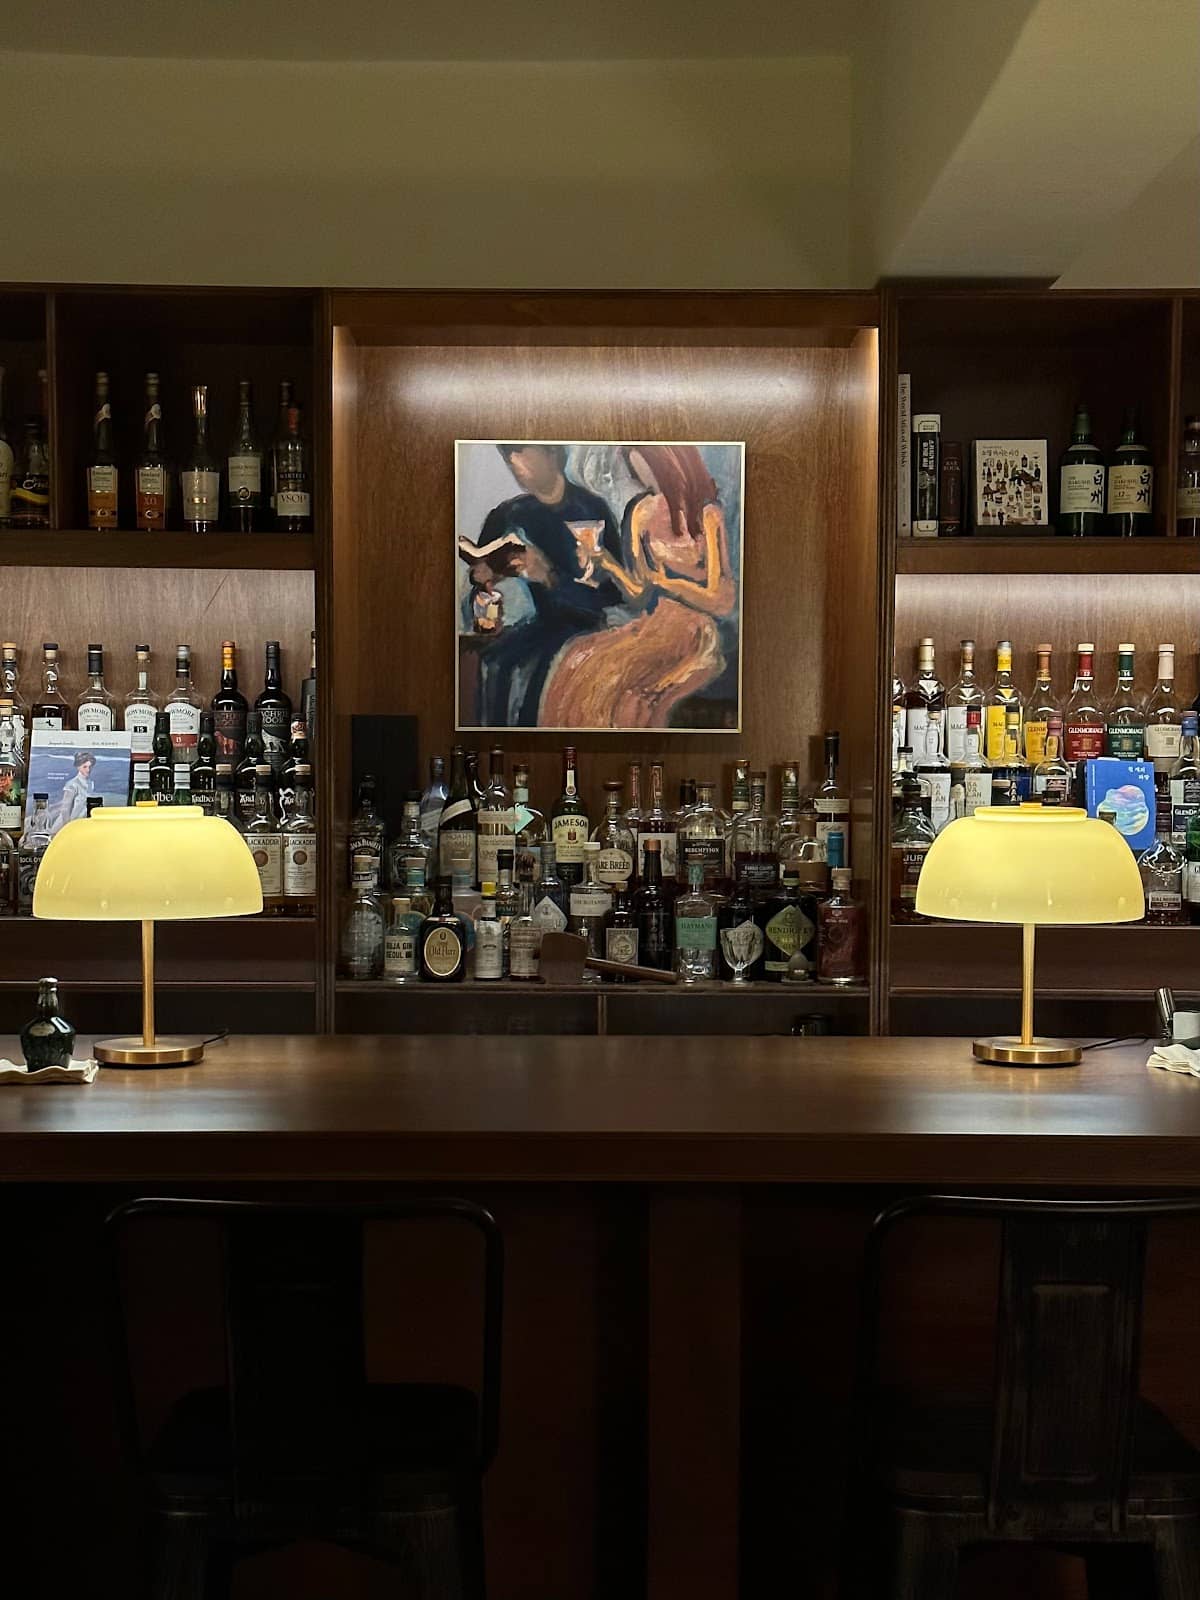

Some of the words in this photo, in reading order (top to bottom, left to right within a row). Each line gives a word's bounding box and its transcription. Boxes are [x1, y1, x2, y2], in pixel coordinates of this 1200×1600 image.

[1090, 469, 1104, 507] 白州
[1136, 468, 1152, 506] 白州
[903, 853, 924, 862] JUR
